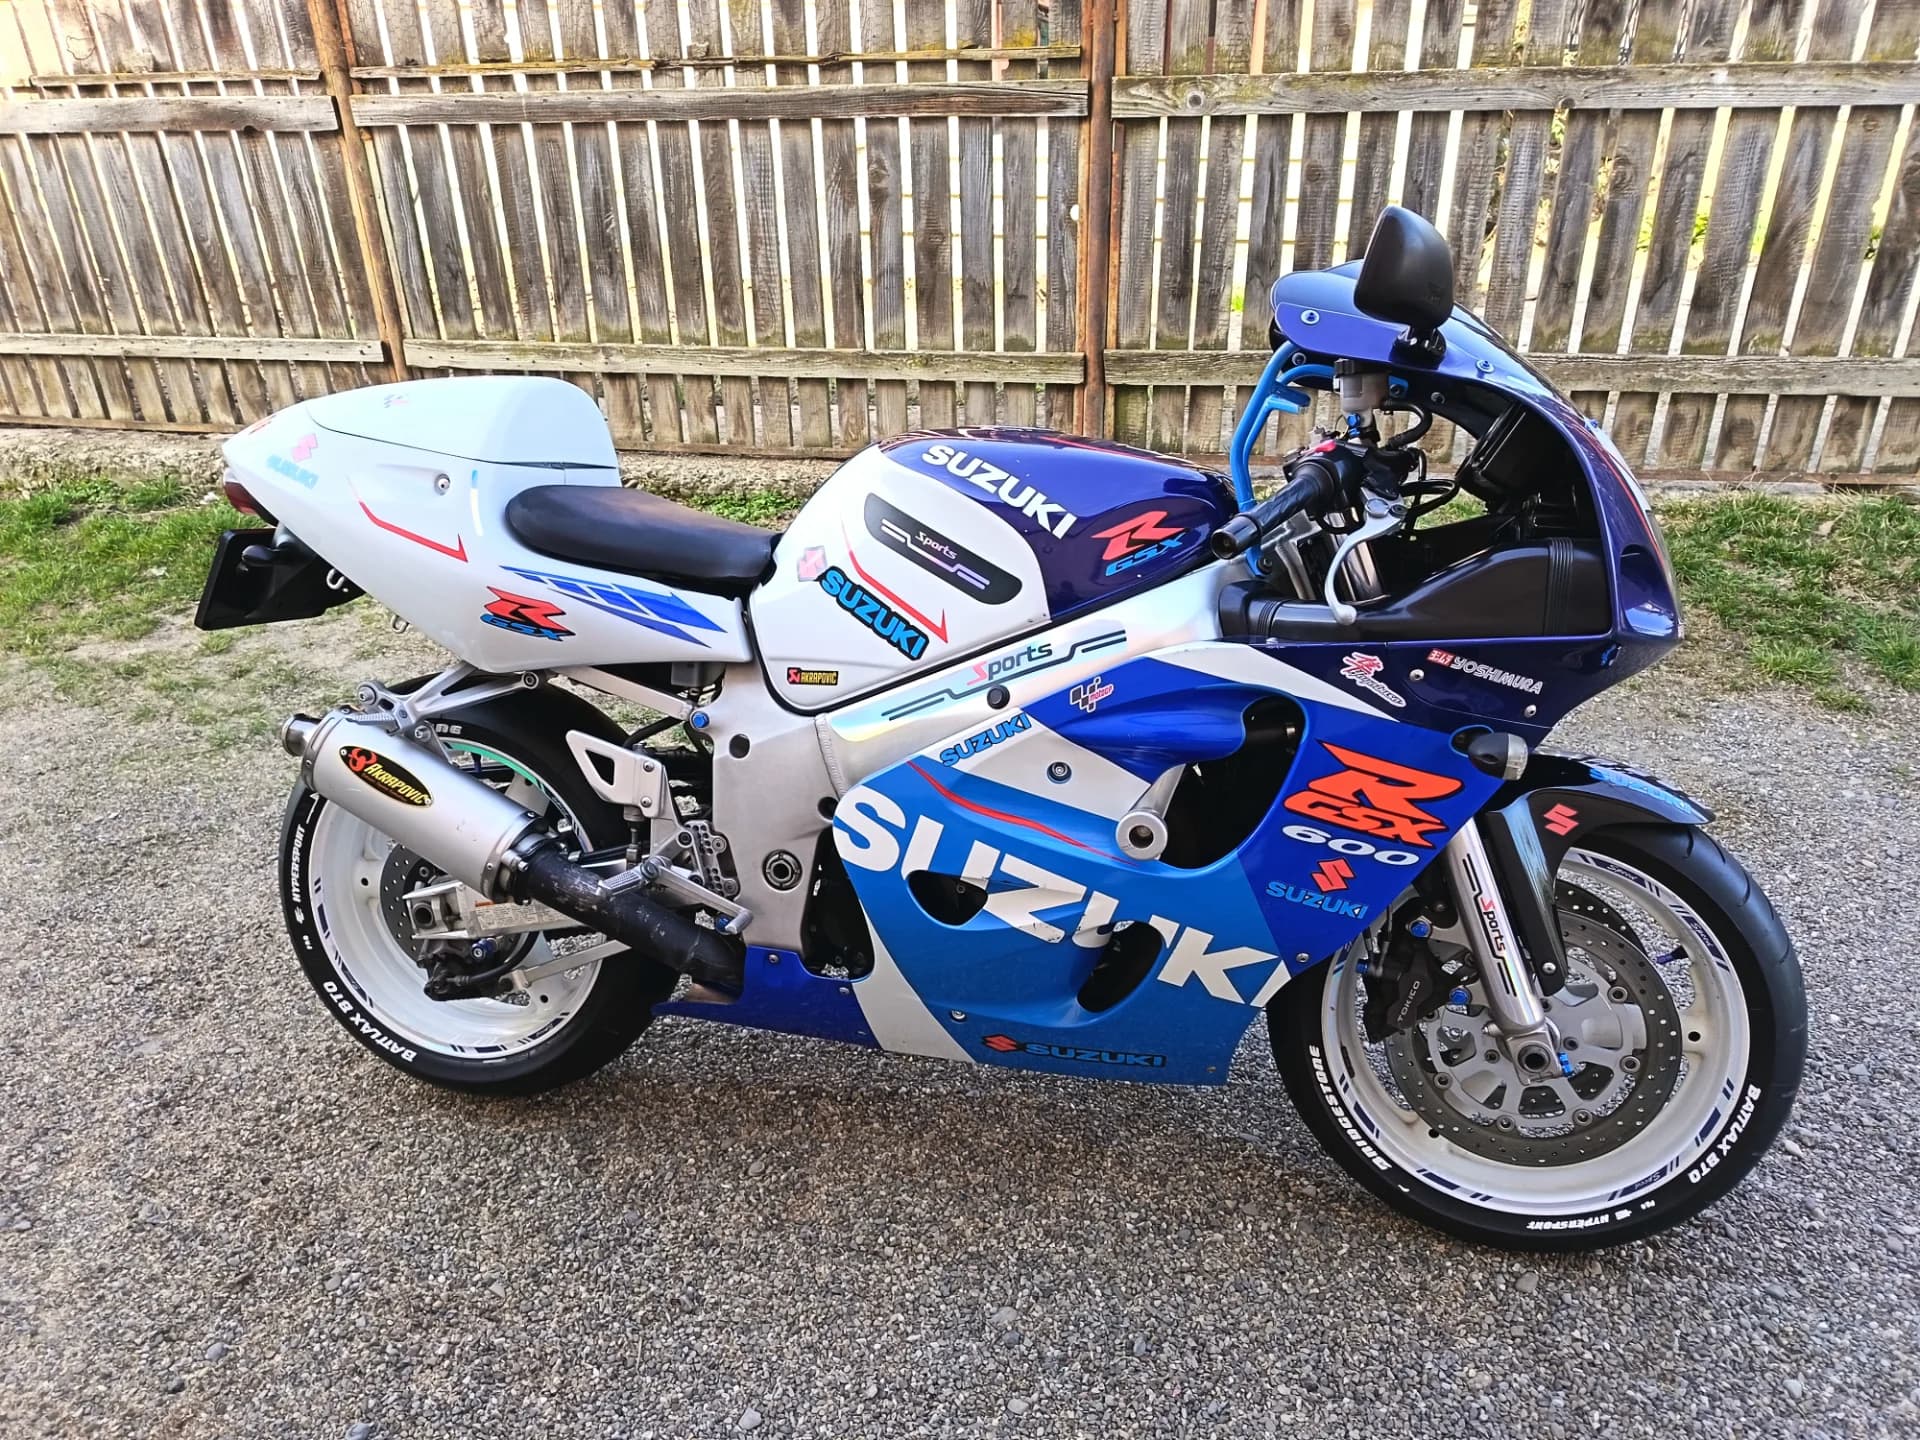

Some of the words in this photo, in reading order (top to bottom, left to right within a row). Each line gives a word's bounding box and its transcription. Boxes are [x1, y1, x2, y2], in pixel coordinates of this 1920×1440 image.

[921, 444, 1077, 540] SUZUKI
[915, 531, 958, 560] Sports
[1091, 511, 1185, 561] R
[1105, 531, 1185, 577] GSX
[819, 567, 928, 659] SUZUKI
[967, 641, 1053, 686] Sports
[1451, 655, 1544, 695] YOSHIMURA
[939, 712, 1031, 767] SUZUKI
[1308, 740, 1464, 829] R
[1283, 790, 1447, 848] GSX
[291, 823, 305, 903] HYPERSPORT
[1281, 825, 1420, 867] 600
[832, 784, 1291, 1008] SUZUKI
[1265, 881, 1369, 921] SUZUKI
[1479, 896, 1507, 953] Sports
[1397, 980, 1420, 1023] TOKICO
[350, 1012, 418, 1063] BATTLAX
[1023, 1042, 1165, 1068] SUZUKI
[1309, 1044, 1392, 1171] BRIDGESTONE
[1717, 1083, 1762, 1157] BATTLAX
